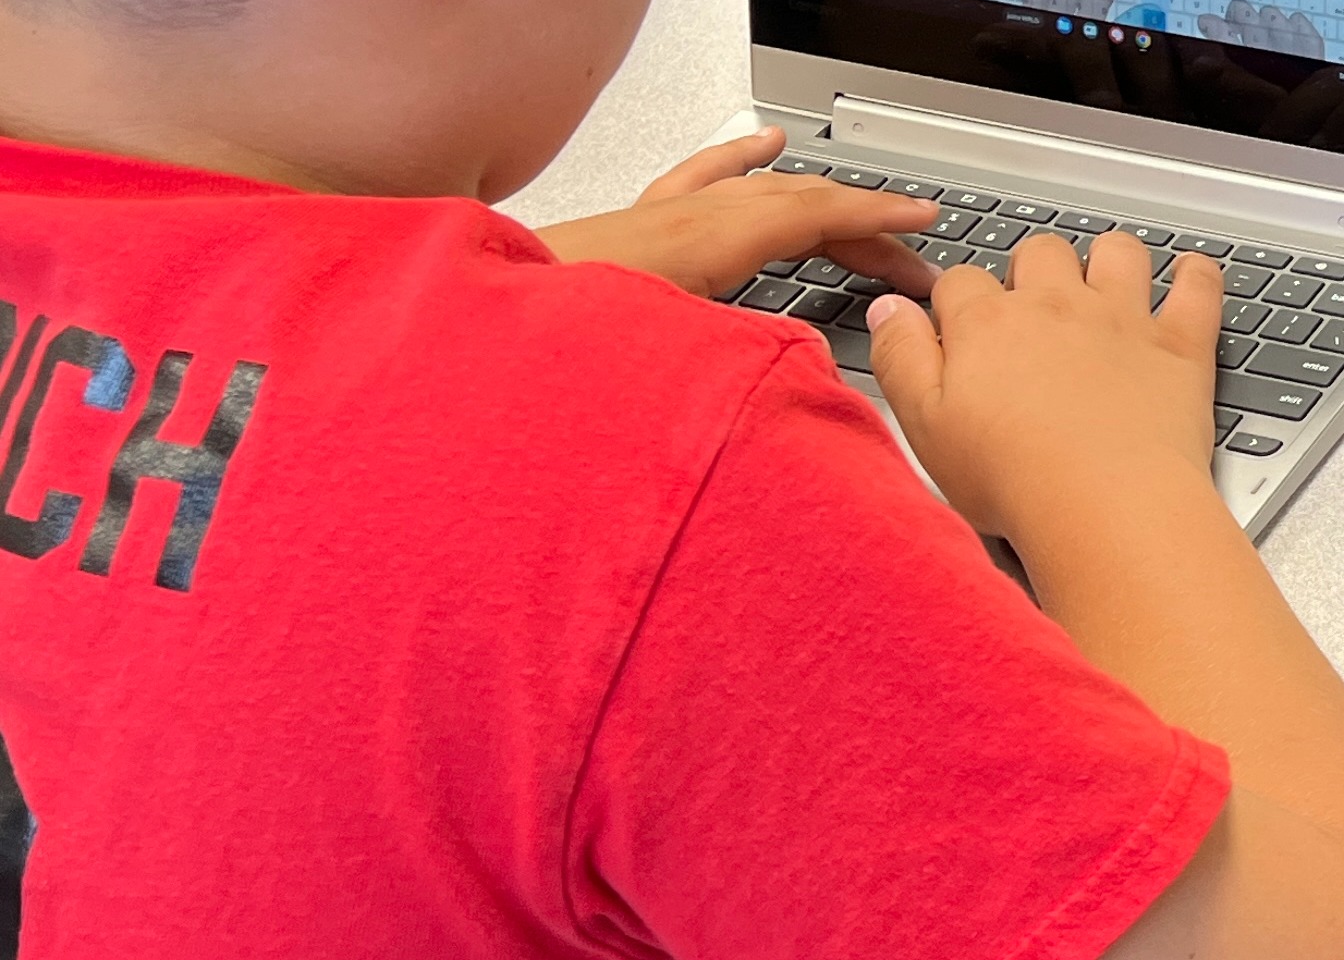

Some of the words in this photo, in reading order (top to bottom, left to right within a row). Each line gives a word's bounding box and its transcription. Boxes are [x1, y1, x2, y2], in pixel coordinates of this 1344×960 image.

[937, 223, 948, 233] 5
[985, 231, 997, 242] 6
[937, 251, 947, 261] t
[821, 264, 836, 274] d
[766, 289, 776, 298] x
[814, 299, 824, 308] c
[1302, 361, 1330, 372] enter
[1279, 394, 1303, 405] shift
